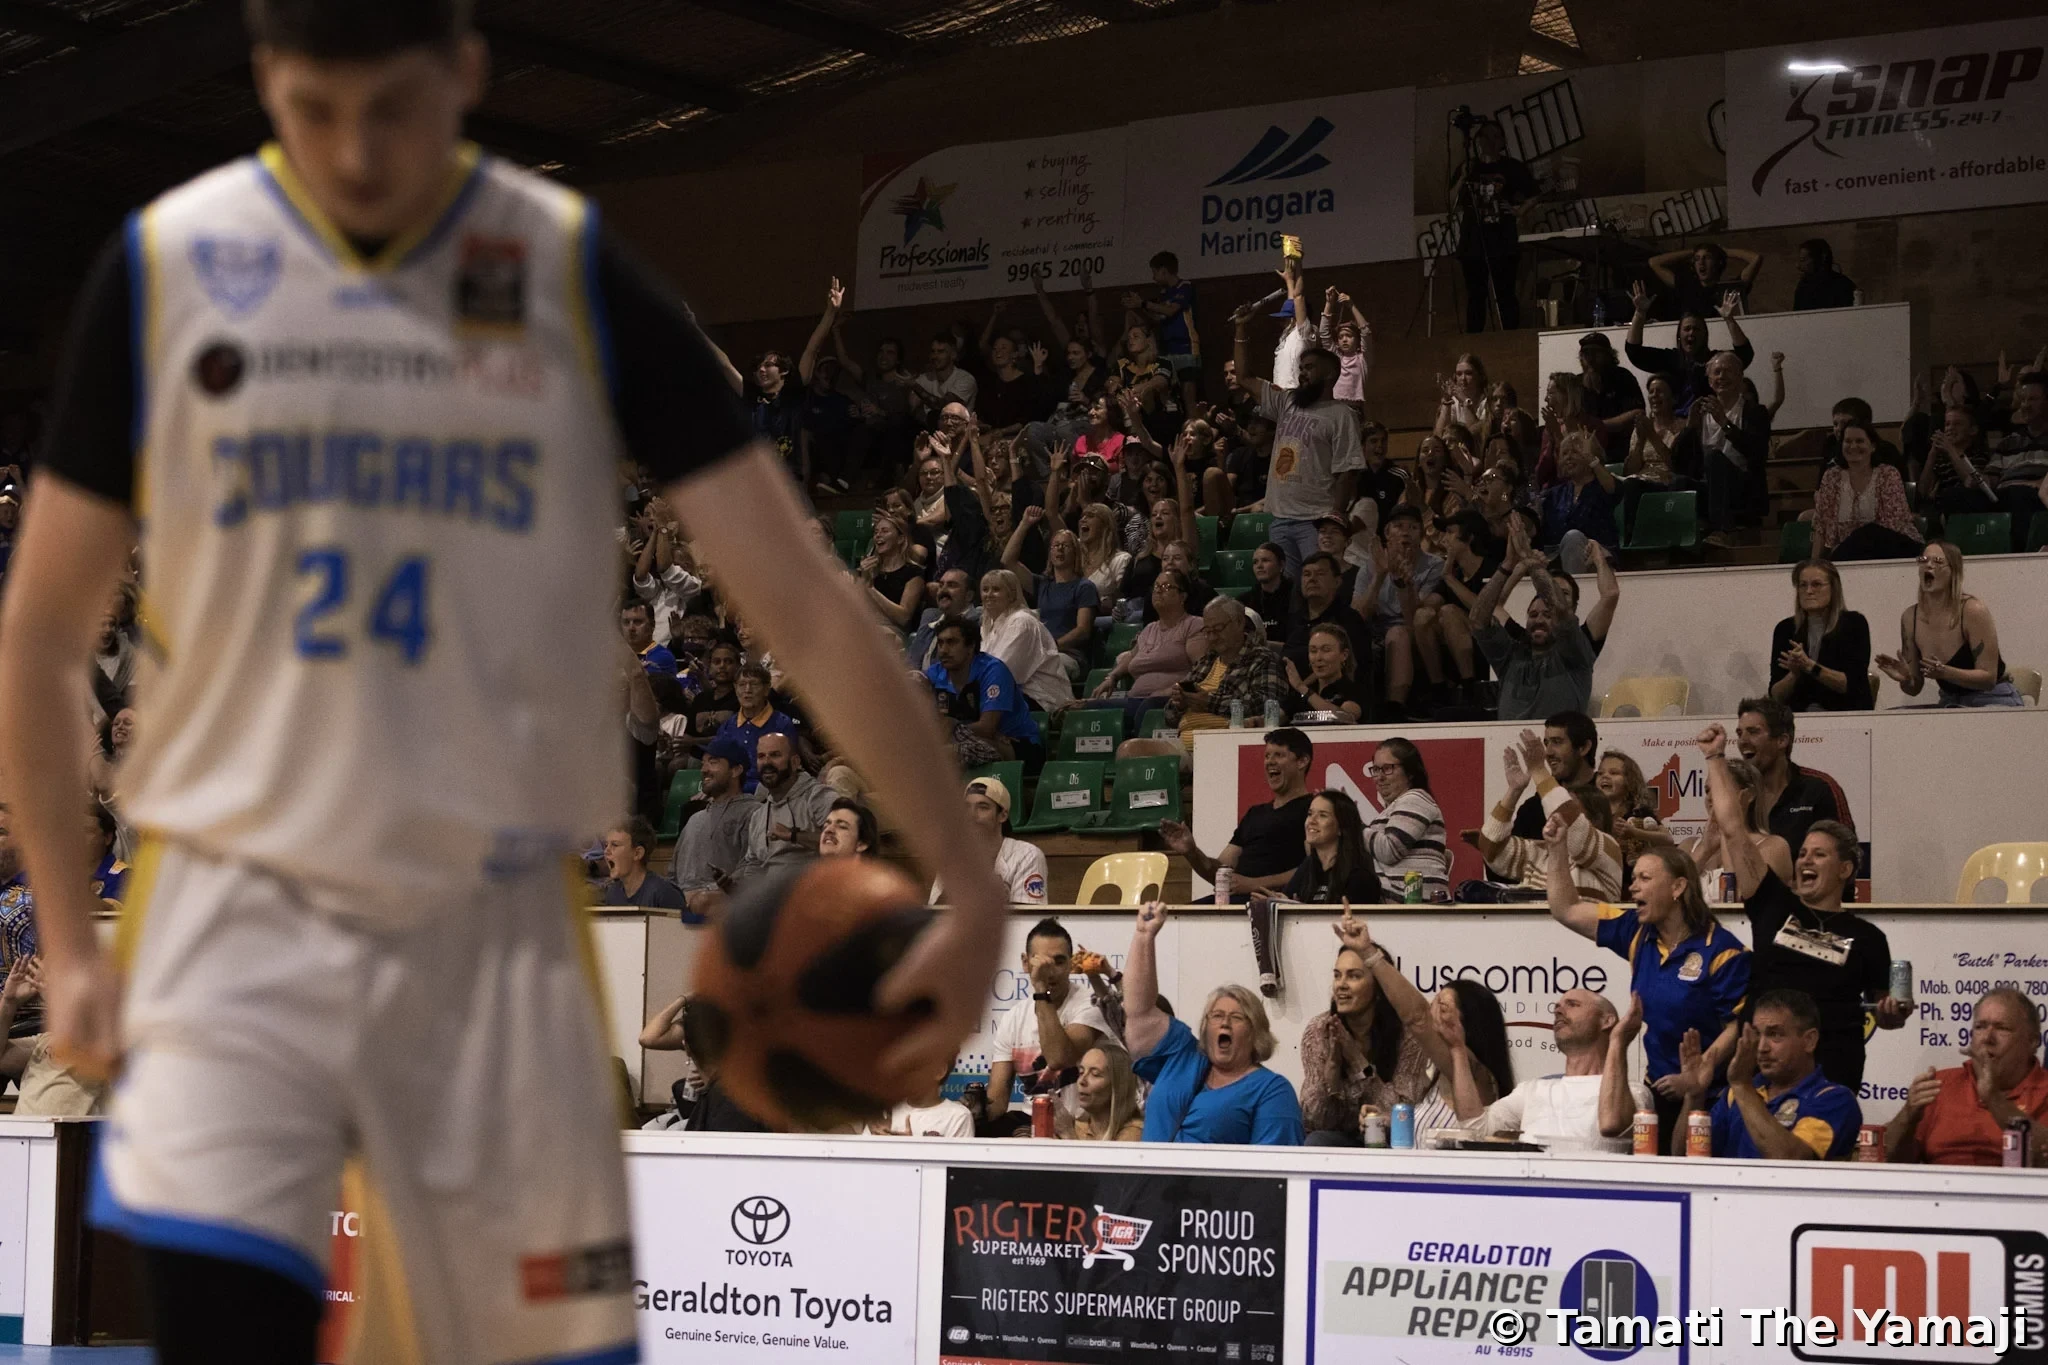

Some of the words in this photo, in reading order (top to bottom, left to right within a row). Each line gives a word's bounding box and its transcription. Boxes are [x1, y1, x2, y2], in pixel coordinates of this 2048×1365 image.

[1042, 154, 1092, 176] buying
[1784, 178, 1819, 195] fast
[1836, 167, 1936, 190] convenient
[1949, 155, 2047, 179] affordable
[1040, 179, 1095, 205] selling
[1202, 188, 1334, 225] Dongara
[1651, 187, 1725, 237] chill
[1037, 207, 1101, 234] renting
[1001, 242, 1048, 257] residential
[1063, 236, 1113, 252] commercial
[1201, 227, 1282, 257] Marine
[880, 237, 990, 275] Professionals
[1059, 255, 1105, 277] 2000
[897, 278, 939, 293] midwest
[940, 276, 968, 291] realty
[213, 428, 538, 534] COUGARS
[1976, 524, 1985, 535] 10
[295, 549, 430, 668] 24
[1091, 721, 1100, 733] 05
[1641, 738, 1666, 747] Make
[1069, 773, 1079, 785] 06
[1145, 768, 1155, 781] 07
[1953, 952, 2000, 968] "Butch"
[1920, 979, 1951, 995] Mob.
[1955, 980, 1989, 995] 0408
[2024, 980, 2048, 995] 780
[1920, 1002, 1944, 1021] Ph.
[1920, 1027, 1952, 1047] Fax.
[953, 1202, 1110, 1254] RIGTERS
[1180, 1208, 1254, 1241] PROUD
[725, 1249, 793, 1267] TOYOTA
[972, 1240, 1090, 1259] SUPERMARKETS
[1408, 1241, 1552, 1267] GERALDTON
[1011, 1257, 1024, 1265] est
[1026, 1256, 1046, 1267] 1969
[1157, 1244, 1276, 1278] SPONSORS
[631, 1280, 780, 1317] Geraldton
[790, 1287, 893, 1328] Toyota
[981, 1288, 1049, 1314] RIGTERS
[1054, 1291, 1177, 1320] SUPERMARKET
[1183, 1299, 1241, 1323] GROUP
[2013, 1253, 2045, 1350] COMMS
[665, 1327, 712, 1342] Genuine
[714, 1330, 760, 1346] Service,
[762, 1332, 811, 1348] Genuine
[814, 1335, 849, 1350] Value.
[1037, 1336, 1057, 1345] Queens
[1166, 1343, 1187, 1352] Queens
[1196, 1344, 1217, 1353] Central
[1475, 1345, 1492, 1356] AU
[1497, 1346, 1534, 1358] 48915
